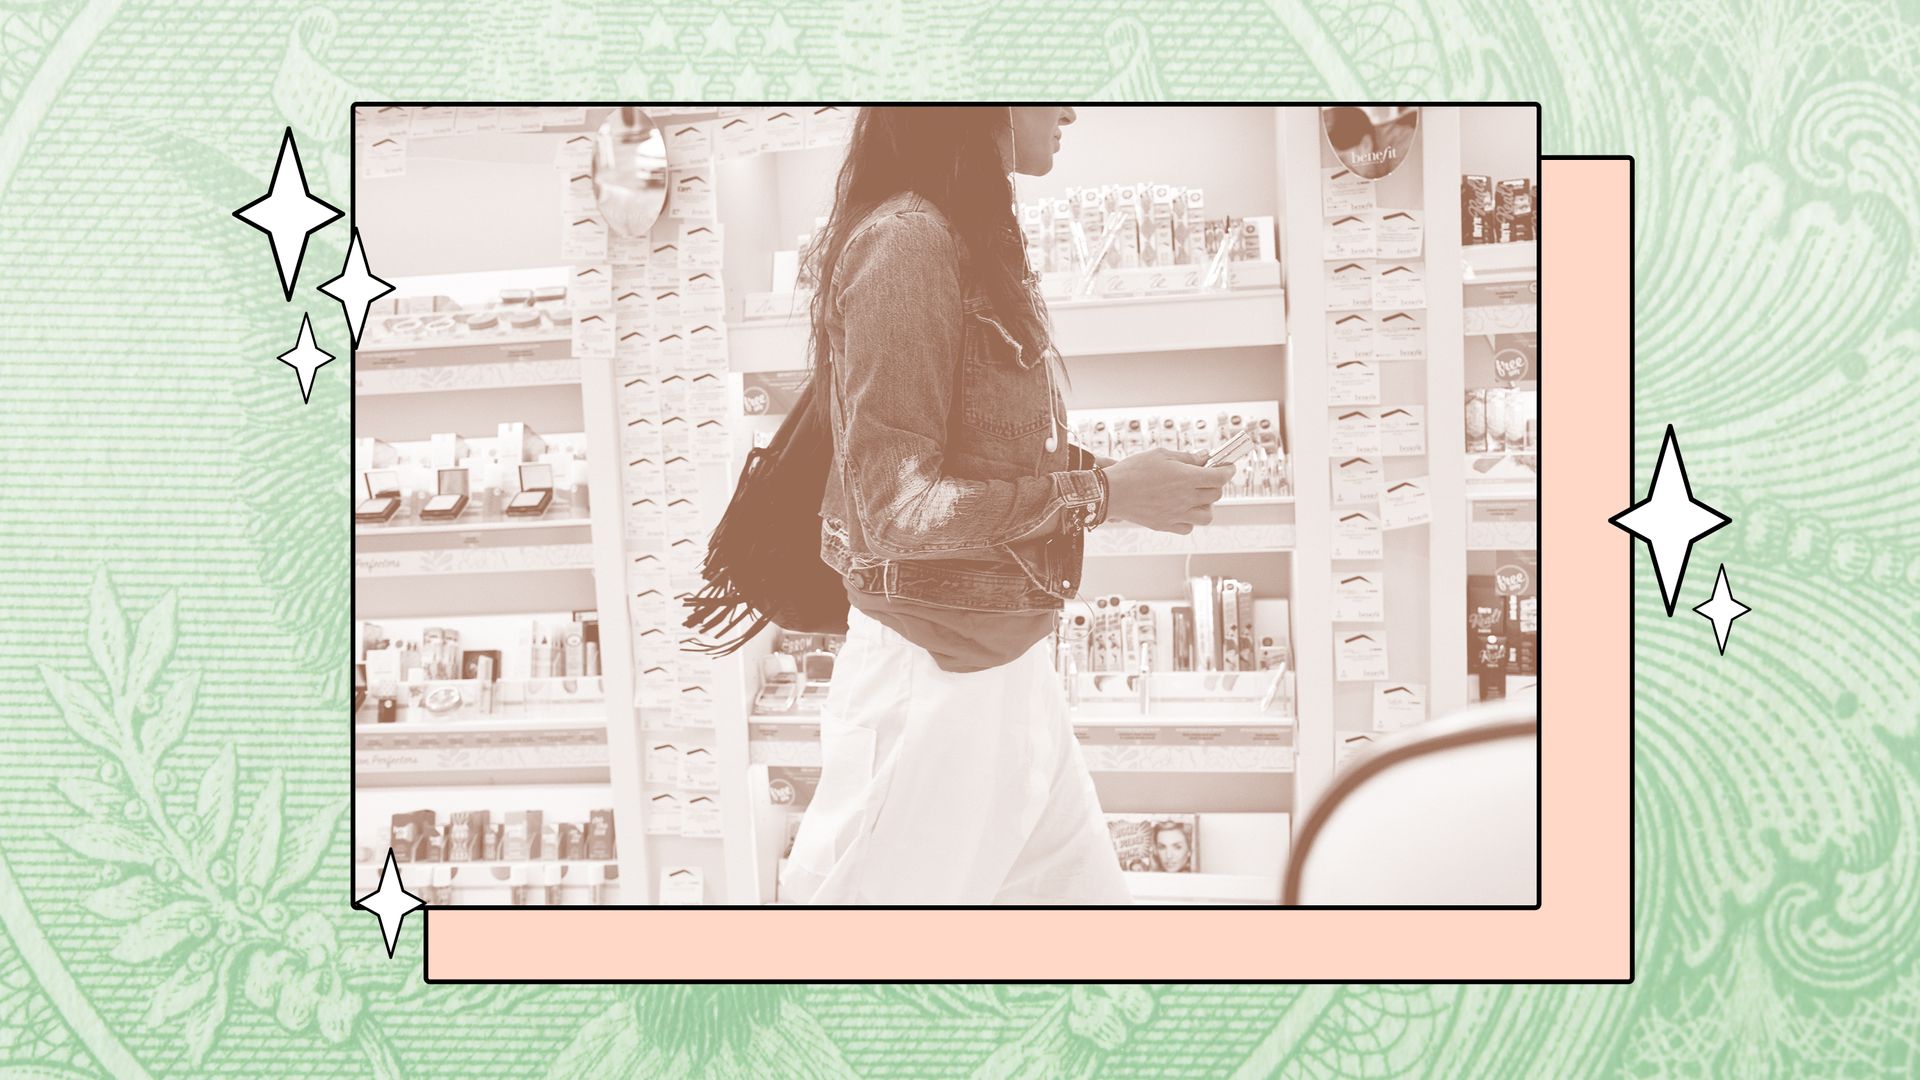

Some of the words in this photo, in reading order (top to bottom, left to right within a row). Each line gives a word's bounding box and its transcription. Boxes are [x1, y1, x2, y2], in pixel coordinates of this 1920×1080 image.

[1351, 146, 1396, 164] benefit
[1496, 357, 1525, 377] free
[1497, 573, 1525, 592] free
